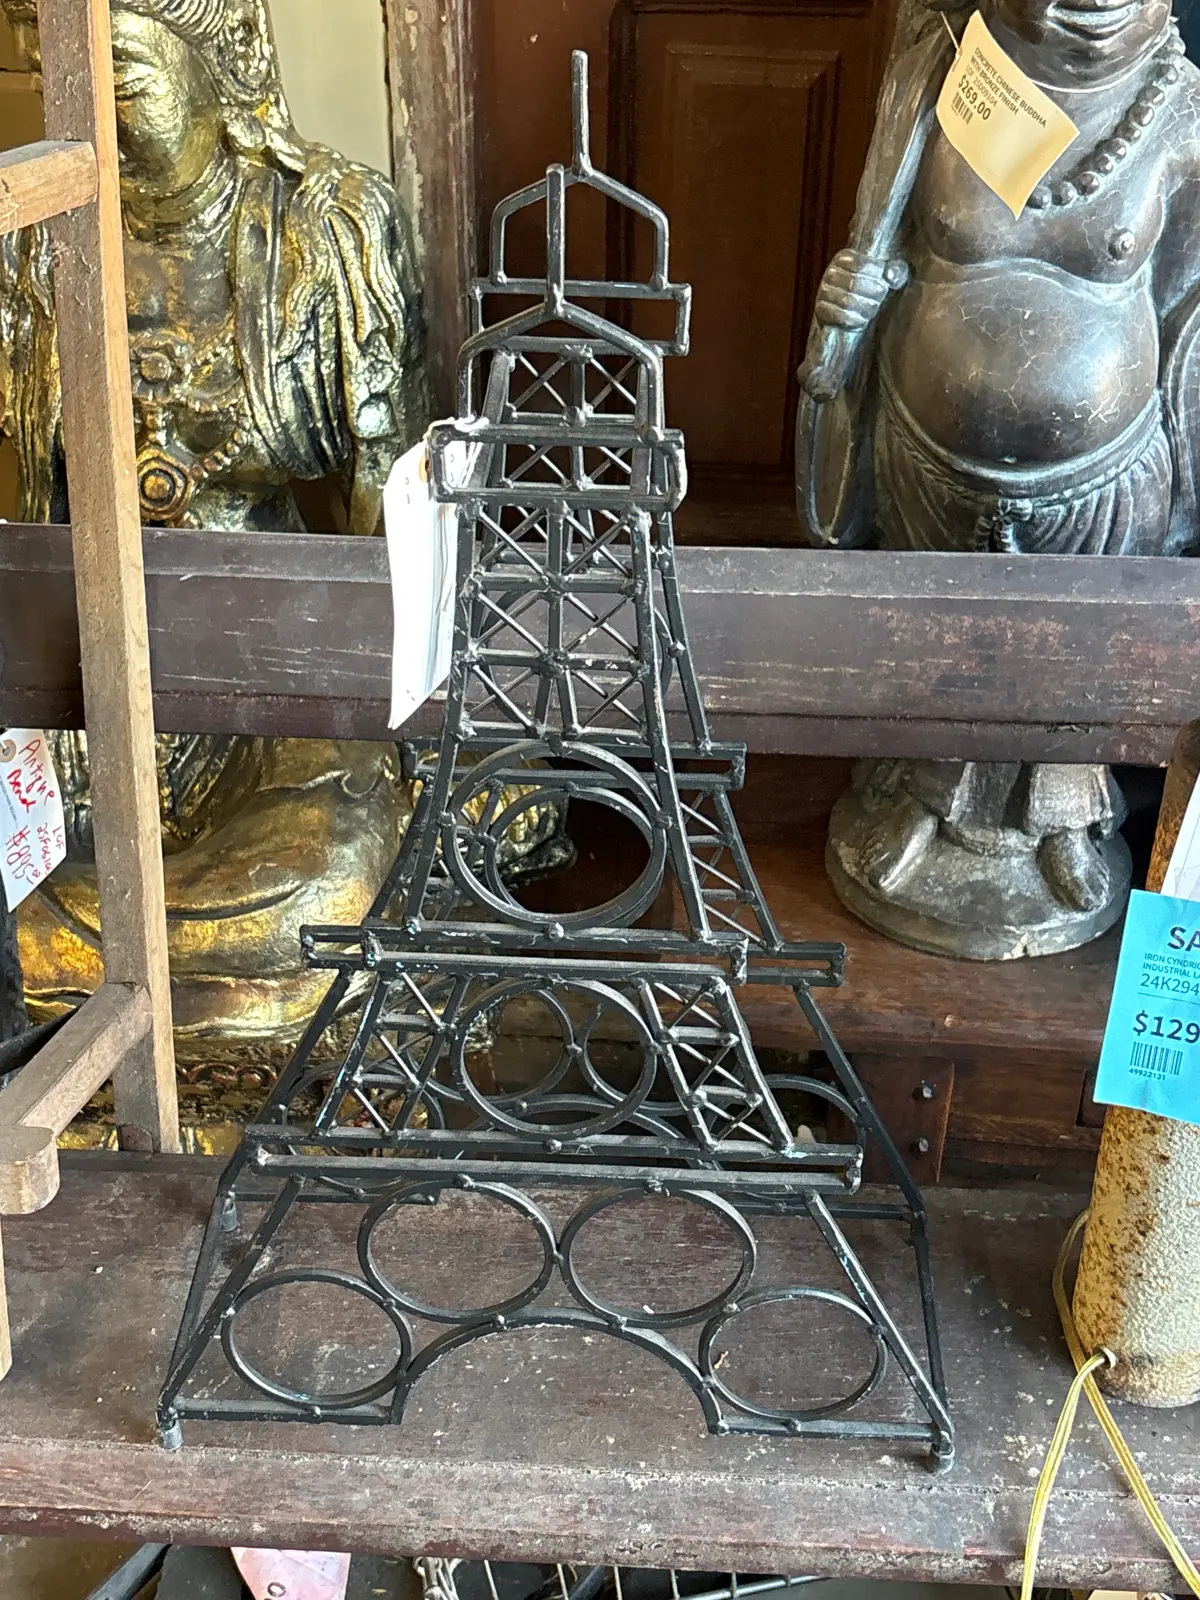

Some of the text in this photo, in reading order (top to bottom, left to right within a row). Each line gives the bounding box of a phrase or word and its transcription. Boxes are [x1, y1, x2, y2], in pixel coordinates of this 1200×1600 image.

[958, 74, 991, 120] $269.00
[971, 55, 1019, 115] WITH BRONZE FINISH
[975, 47, 1047, 128] CONCRETE CHINESE BUDDHA
[1167, 926, 1200, 952] SA
[1142, 962, 1191, 978] INDUSTRIAL
[1144, 953, 1166, 963] IRON
[1140, 973, 1200, 997] 24K294
[1132, 1009, 1200, 1044] $129
